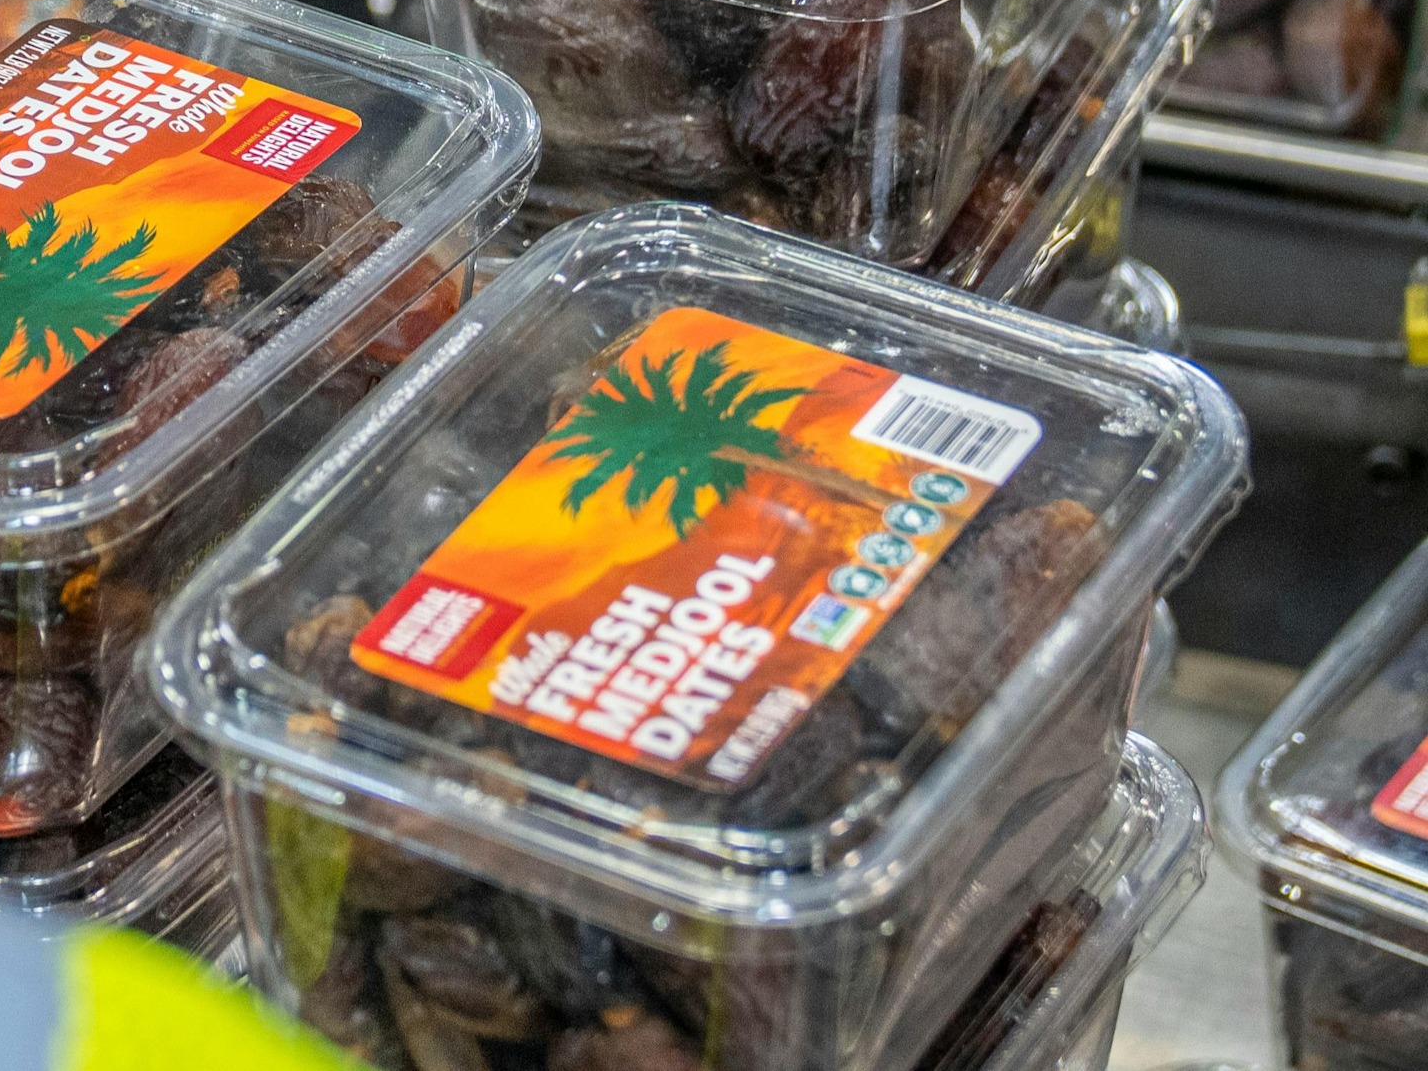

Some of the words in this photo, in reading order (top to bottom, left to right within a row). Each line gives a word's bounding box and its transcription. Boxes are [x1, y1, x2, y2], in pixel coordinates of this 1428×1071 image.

[14, 49, 38, 59] 2
[21, 38, 54, 54] WT.
[37, 25, 70, 44] NET
[4, 54, 32, 68] LB
[73, 70, 213, 164] FRESH
[168, 83, 243, 132] Whole
[241, 114, 312, 163] DELIGHTS
[262, 121, 335, 169] NATURAL
[489, 631, 572, 704] Whole
[528, 586, 670, 719] FRESH
[580, 555, 772, 738] MEDJOOL
[632, 622, 772, 757] DATES
